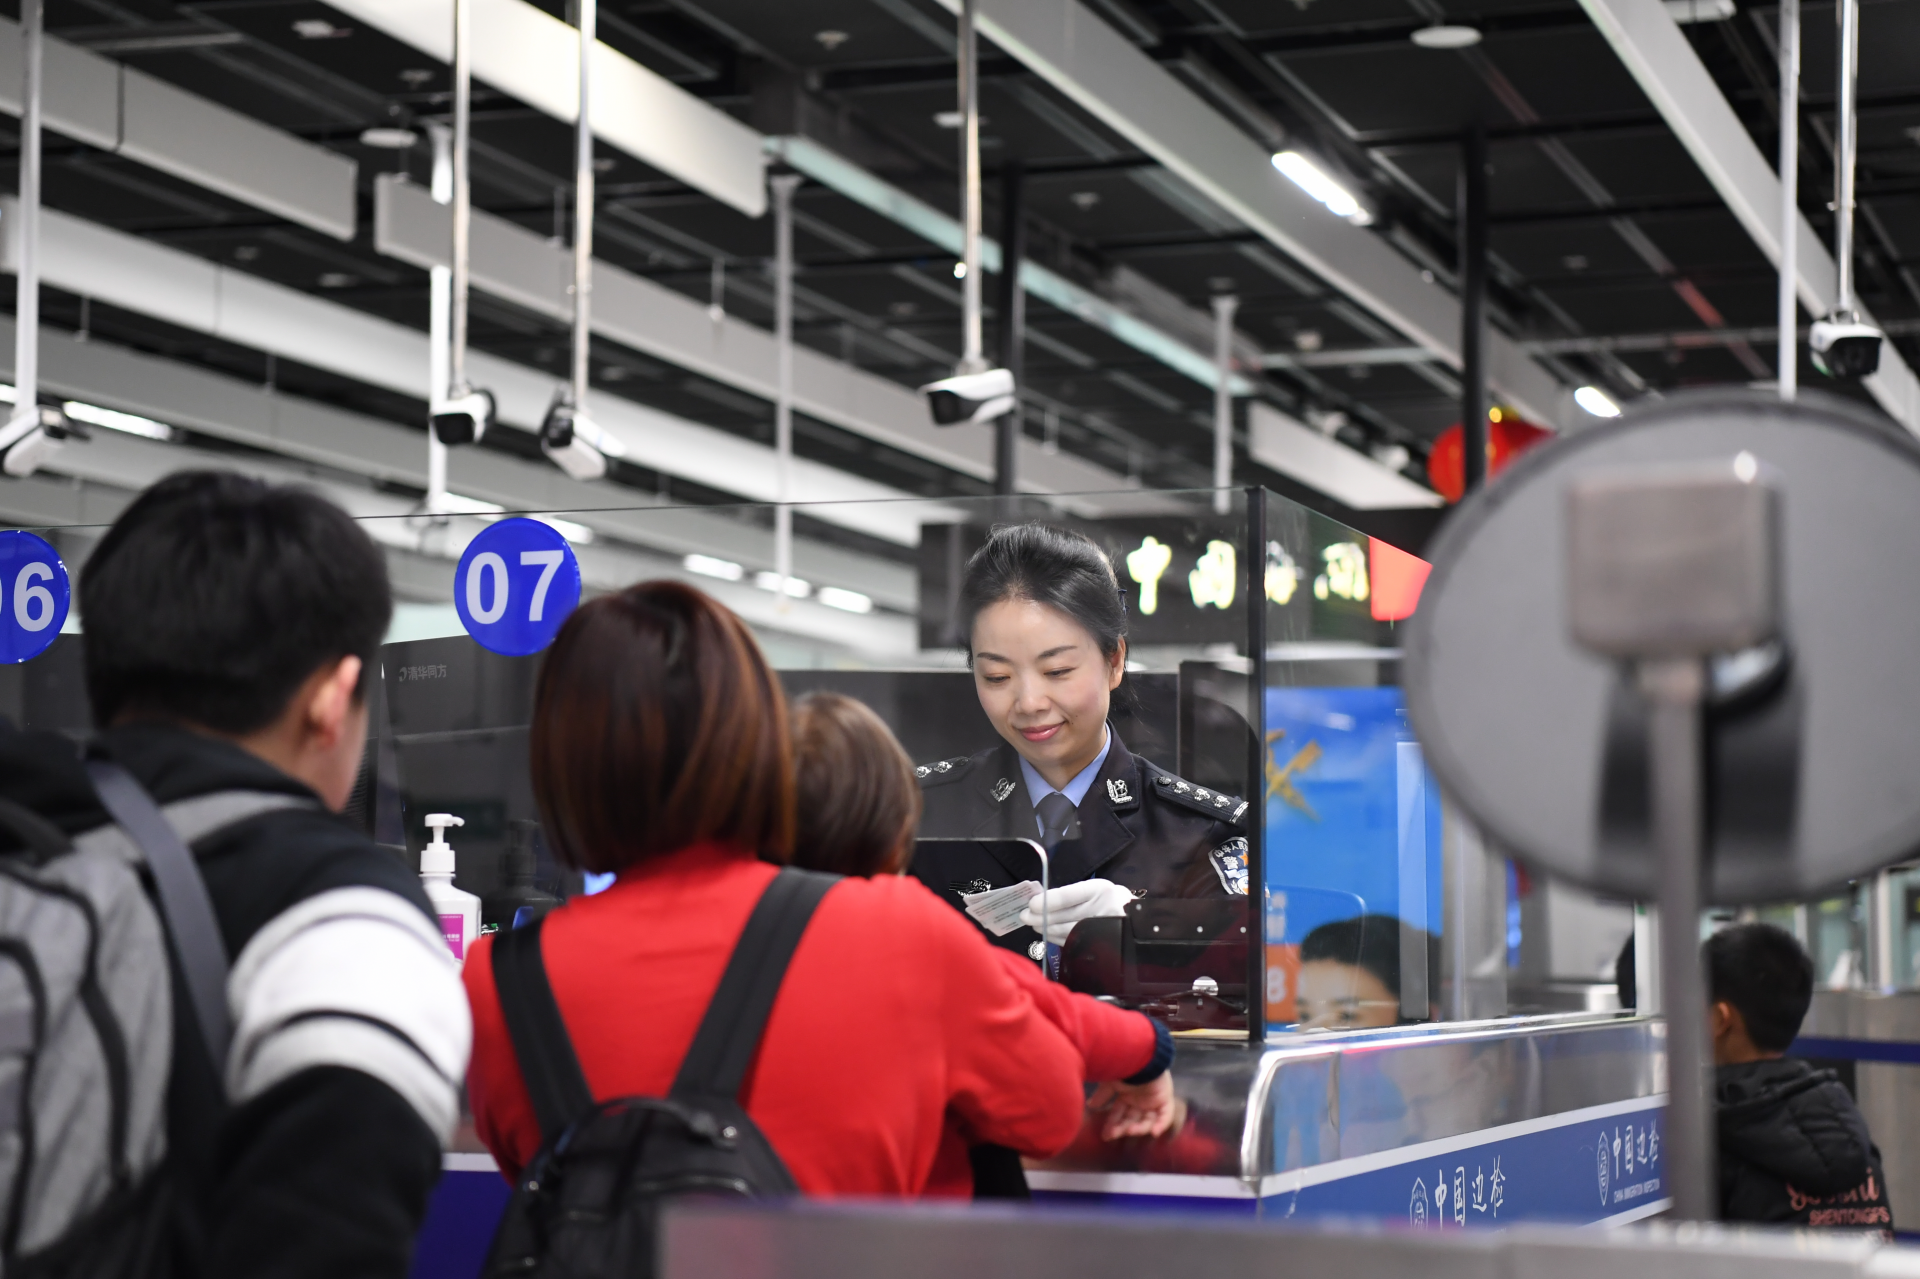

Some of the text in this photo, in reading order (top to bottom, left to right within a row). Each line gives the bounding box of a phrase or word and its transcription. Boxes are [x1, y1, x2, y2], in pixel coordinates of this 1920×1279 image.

[0, 561, 55, 632] 6
[466, 549, 564, 625] 07
[407, 663, 447, 681] 清华同方
[1613, 1118, 1660, 1180] 中国边检
[1434, 1155, 1506, 1230] 中国边检
